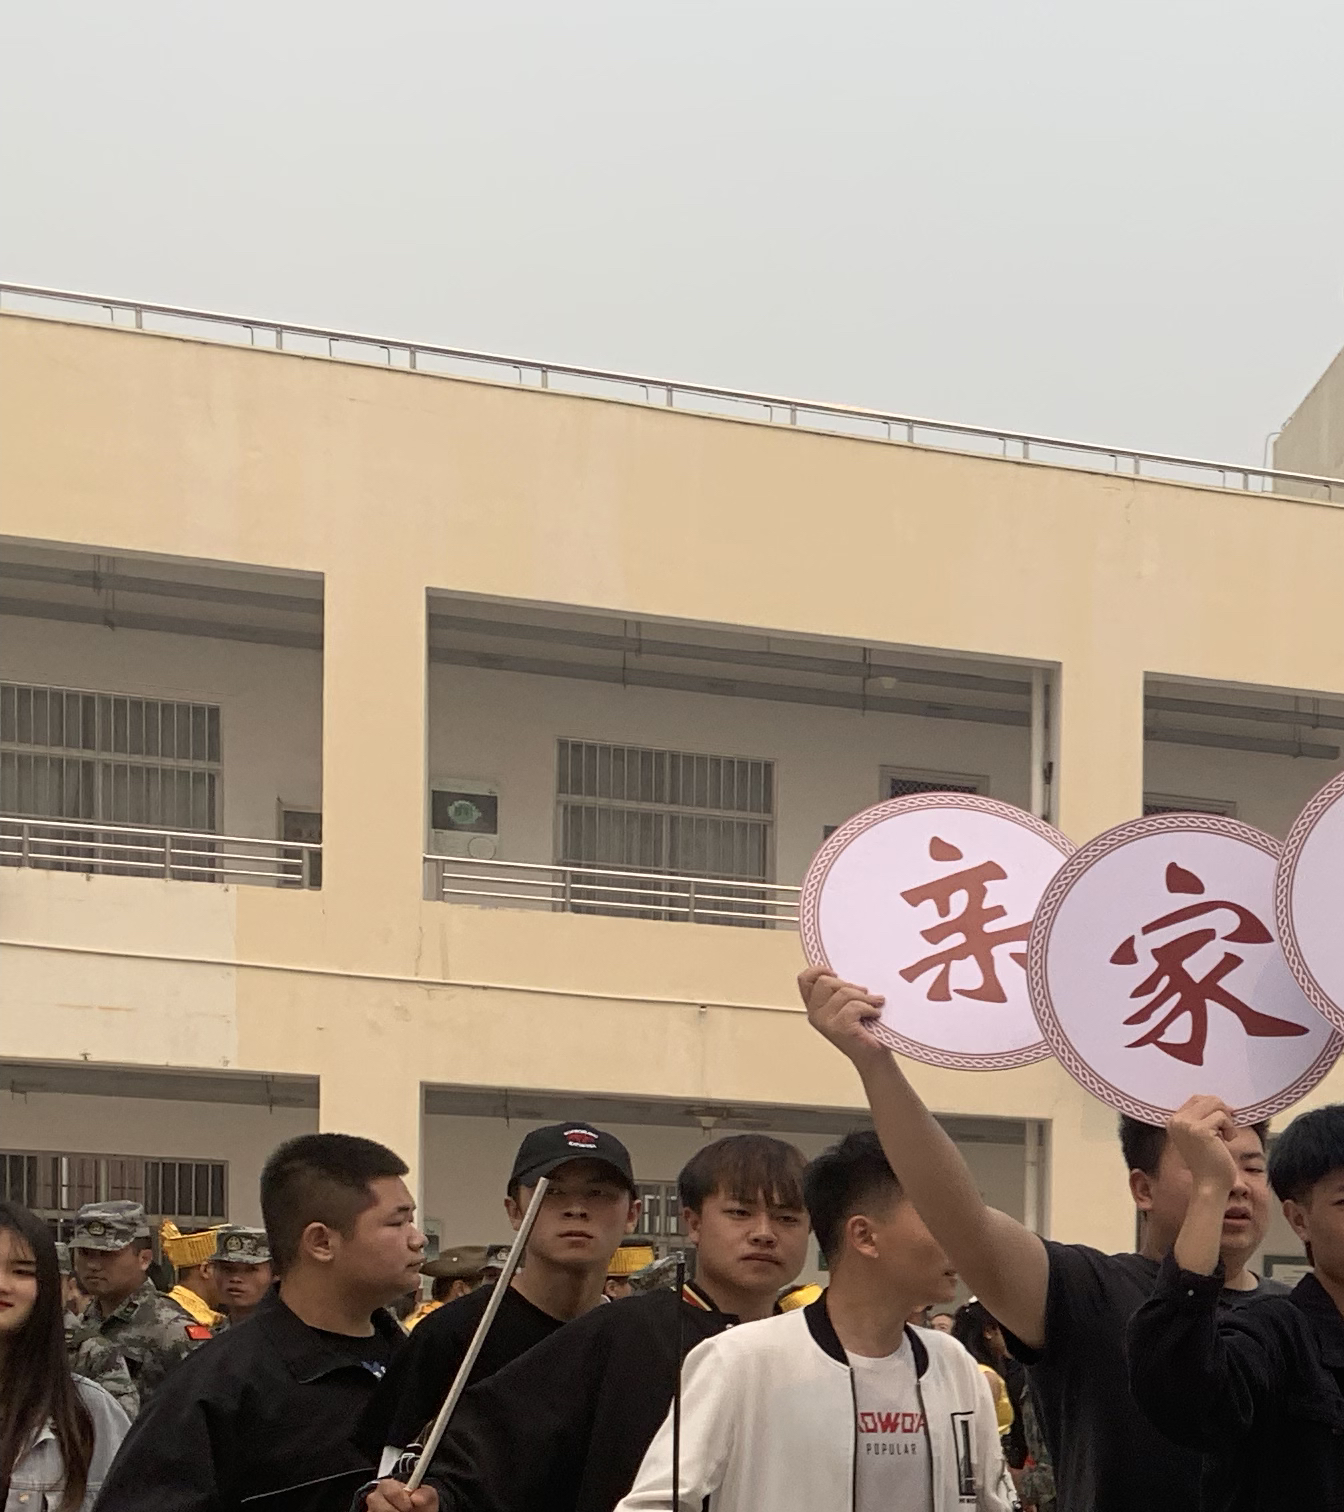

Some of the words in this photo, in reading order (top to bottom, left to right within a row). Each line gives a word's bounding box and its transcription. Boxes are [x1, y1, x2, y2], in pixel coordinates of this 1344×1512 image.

[898, 835, 1029, 1004] 亲
[1109, 861, 1311, 1067] 家
[866, 1442, 918, 1456] POPULAR
